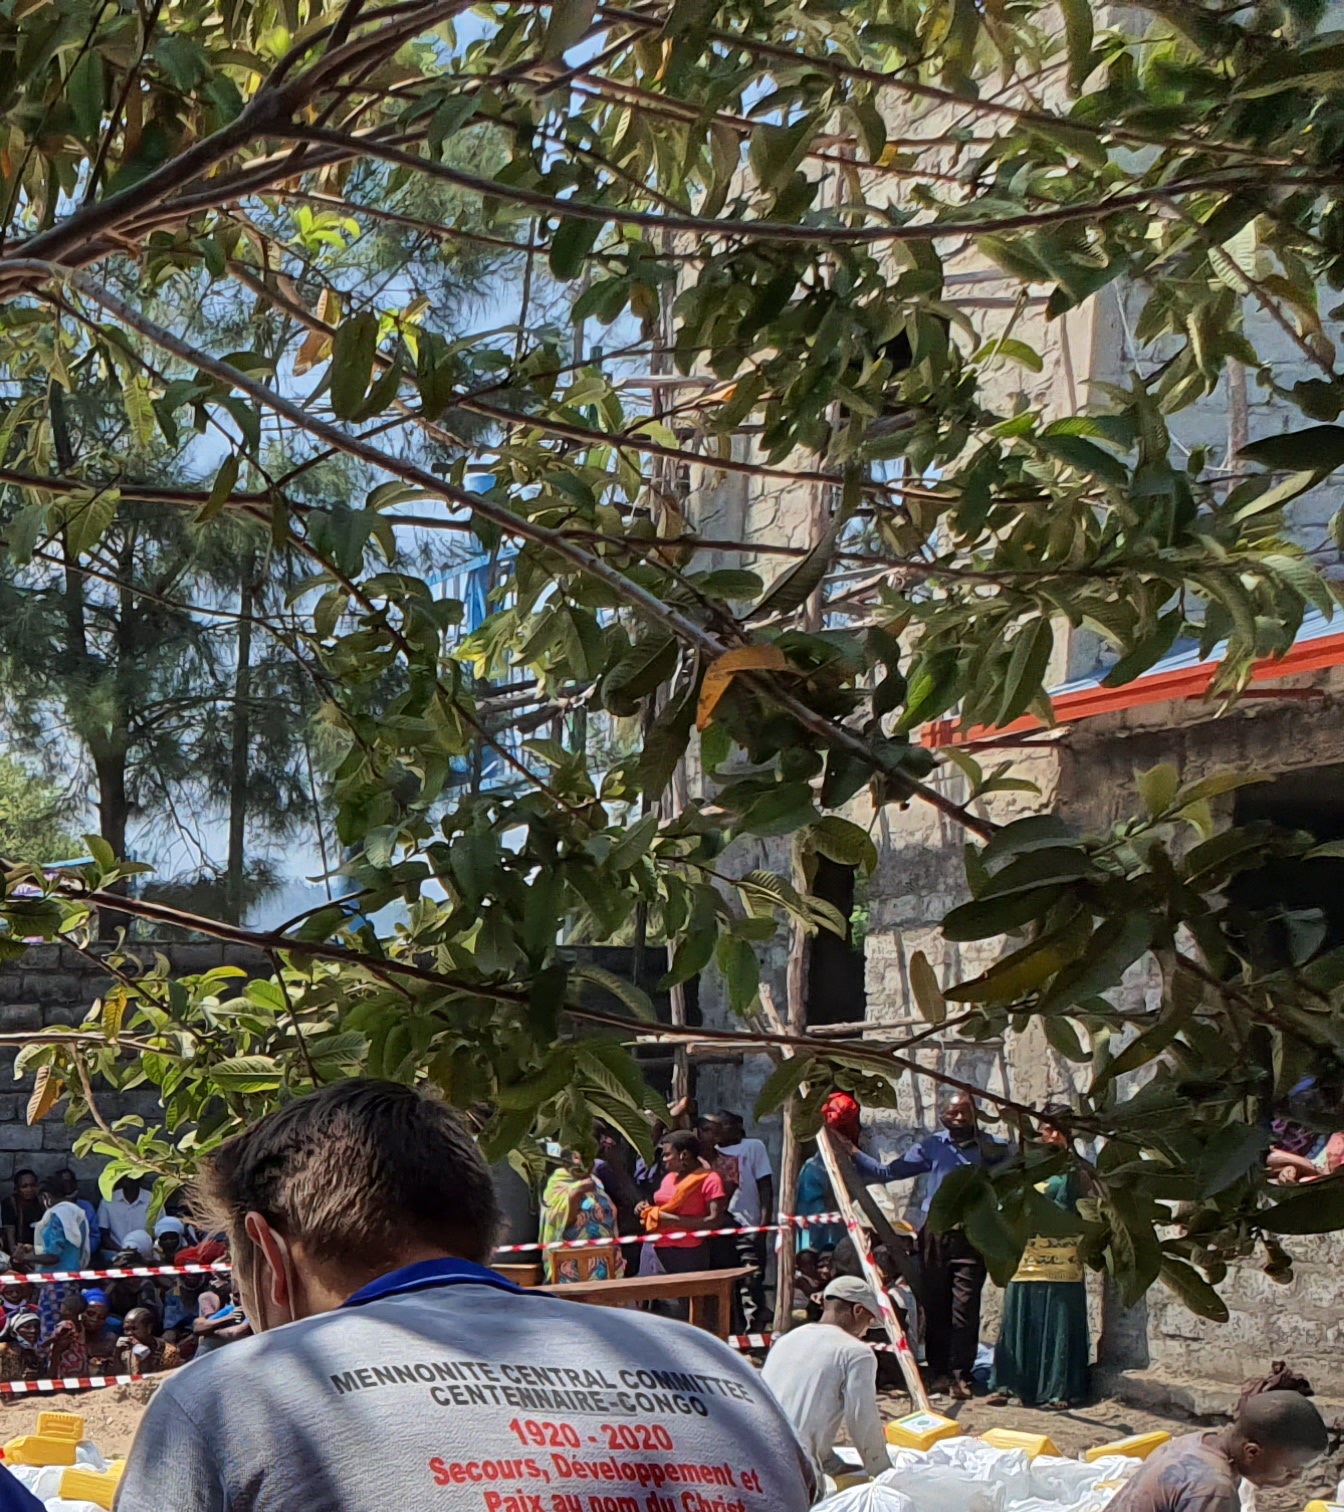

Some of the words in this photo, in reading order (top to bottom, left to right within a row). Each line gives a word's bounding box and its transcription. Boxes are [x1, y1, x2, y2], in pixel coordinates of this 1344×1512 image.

[330, 1361, 495, 1395] MENNONITE
[500, 1364, 614, 1389] CENTRAL
[621, 1369, 755, 1405] COMMITTEE
[430, 1386, 708, 1417] CENTENNAIRE-CONGO
[509, 1418, 580, 1449] 1920
[601, 1423, 674, 1451] 2020
[428, 1457, 551, 1486] Secours,
[554, 1453, 735, 1488] Développement
[741, 1467, 765, 1494] et
